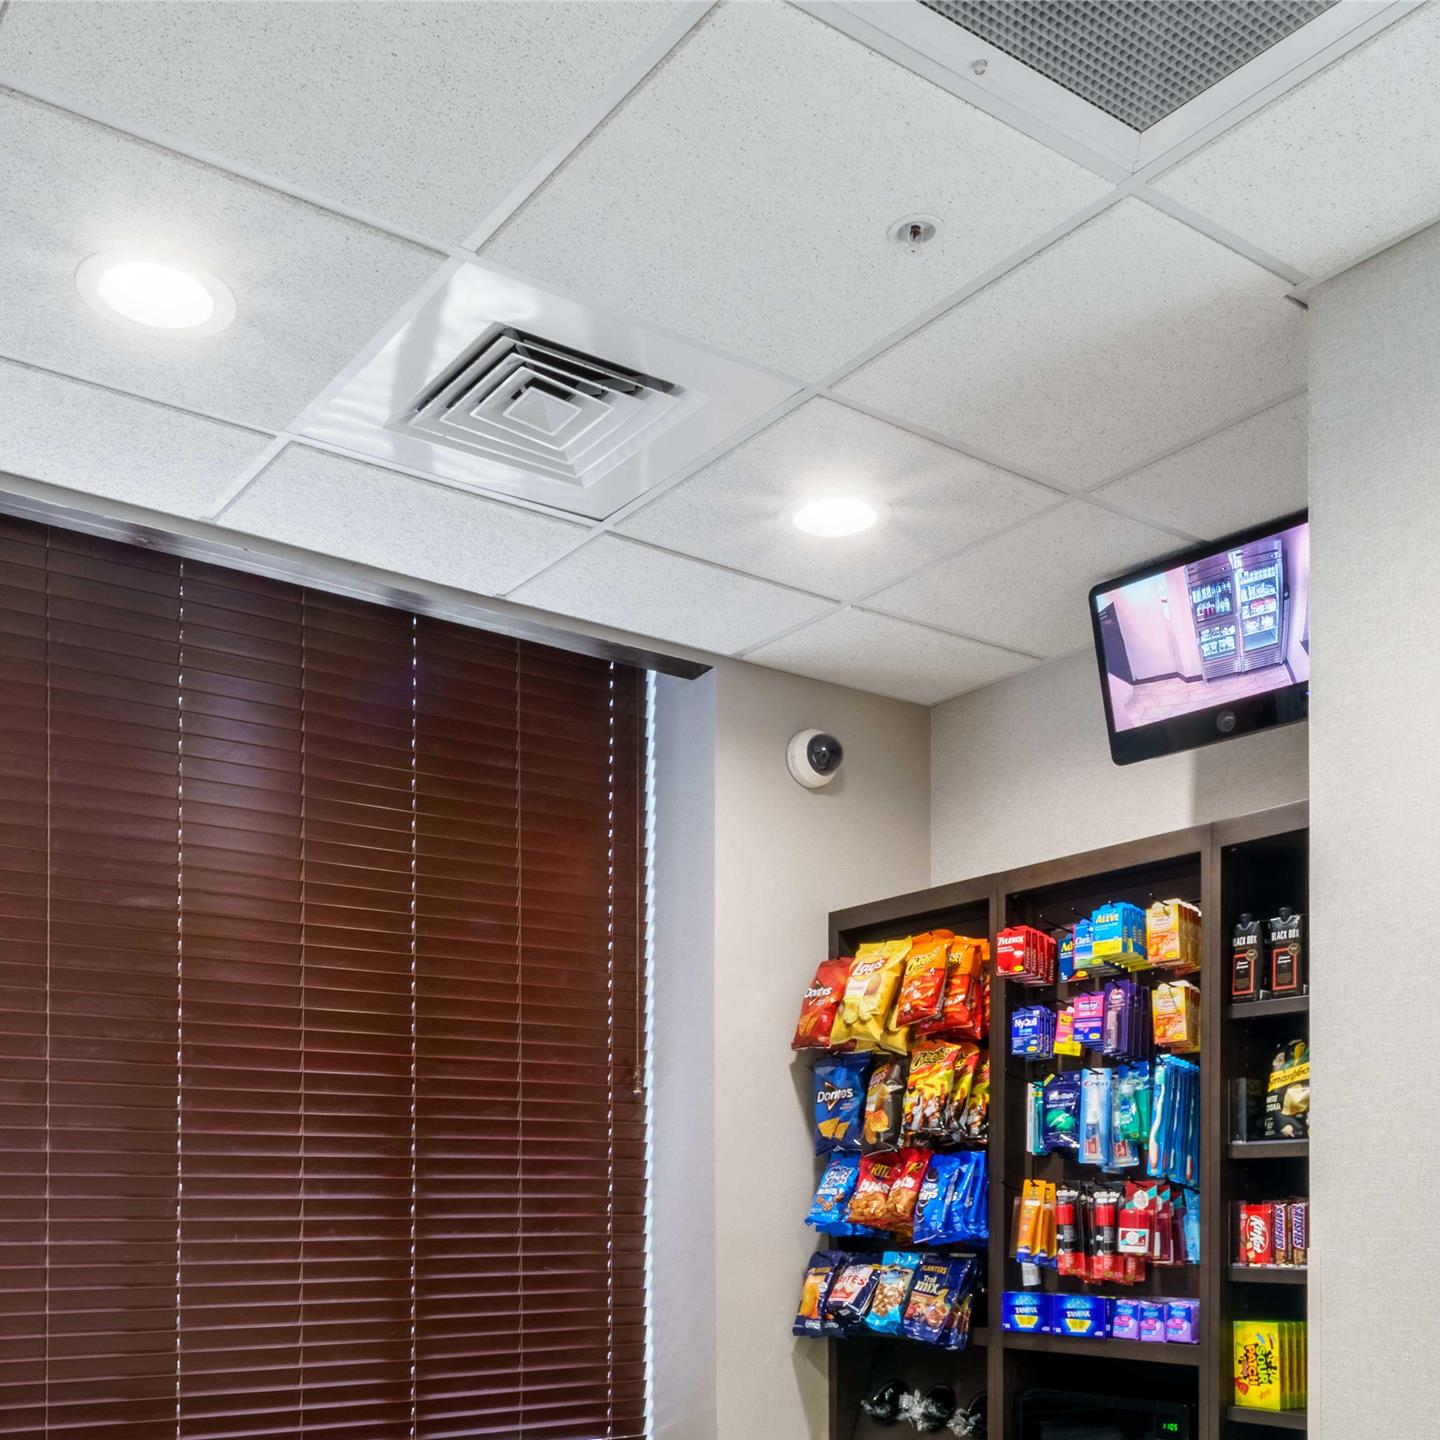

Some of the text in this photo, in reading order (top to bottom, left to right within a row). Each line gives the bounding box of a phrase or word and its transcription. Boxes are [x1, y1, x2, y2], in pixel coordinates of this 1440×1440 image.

[997, 936, 1025, 945] TYLENOL
[1271, 929, 1300, 941] BLACK BOX
[817, 1088, 854, 1103] Doritos
[1066, 1310, 1091, 1318] TAMPAX
[1244, 1344, 1259, 1387] PATCH
[1256, 1345, 1269, 1385] SOUR
